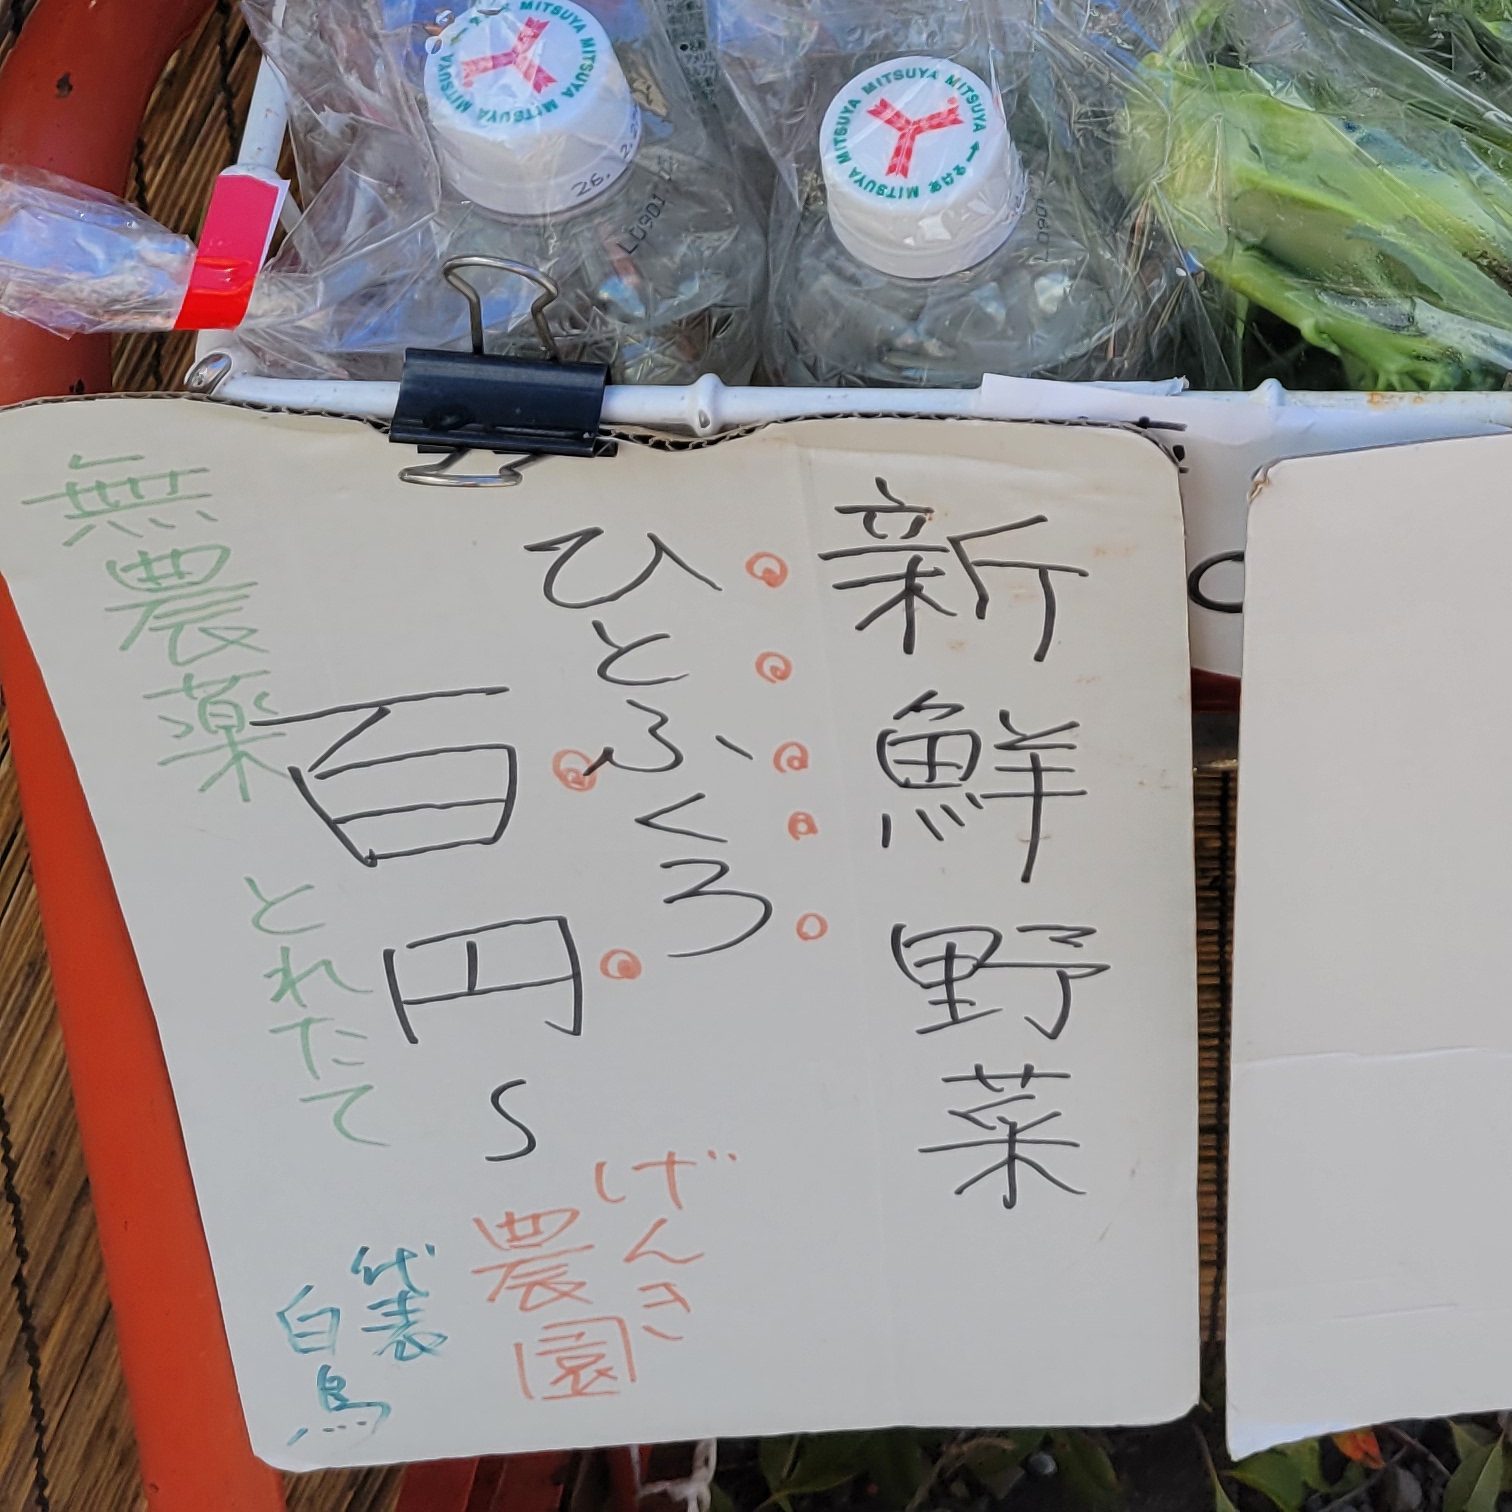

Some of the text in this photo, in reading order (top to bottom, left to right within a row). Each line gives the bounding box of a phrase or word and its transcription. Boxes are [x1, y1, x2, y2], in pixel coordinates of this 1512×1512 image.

[519, 0, 587, 35] MITSUYA
[438, 53, 474, 114] MITSUYA
[561, 37, 597, 98] MITSUYA
[861, 67, 939, 96] MITSUYA
[477, 98, 559, 124] MITSUYA
[833, 98, 862, 165] MITSUYA
[944, 74, 987, 133] MITSUYA
[848, 166, 919, 199] MITSUYA
[523, 525, 773, 959] ひとふくろ
[21, 453, 390, 1148] 無農薬 とれたて
[818, 476, 1111, 1209] 新鮮野菜
[594, 1150, 739, 1341] げんき
[350, 1243, 449, 1363] 代表
[471, 1207, 637, 1401] 農園
